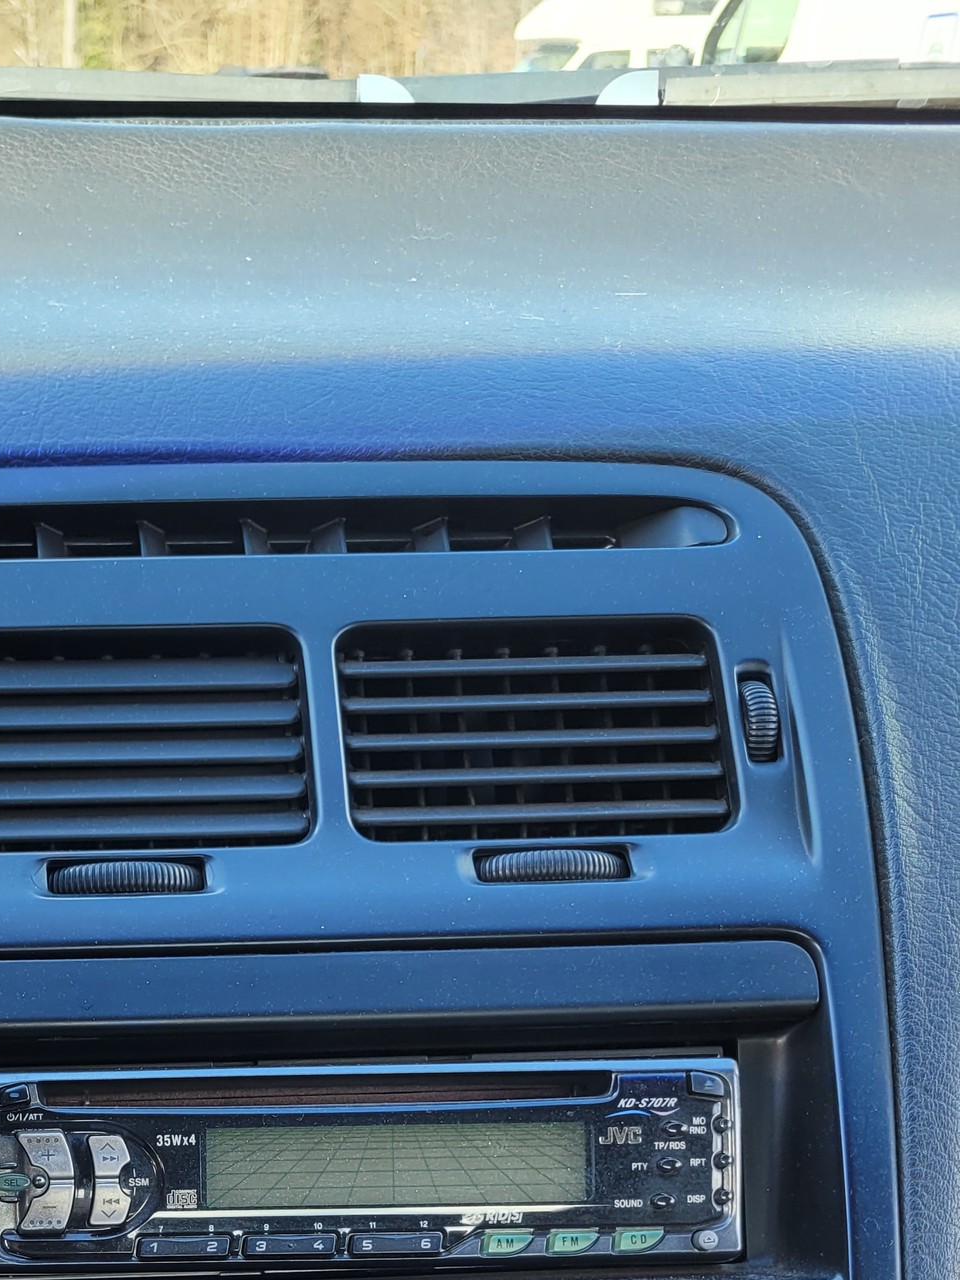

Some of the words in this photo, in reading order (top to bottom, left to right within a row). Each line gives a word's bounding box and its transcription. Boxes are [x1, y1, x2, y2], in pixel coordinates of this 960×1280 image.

[617, 1097, 678, 1108] KD-S707R
[689, 1126, 707, 1135] RND
[599, 1126, 642, 1145] JVC
[156, 1134, 197, 1147] 35Wx4
[653, 1141, 687, 1150] TP/RDS
[631, 1162, 648, 1171] PTY
[689, 1158, 707, 1167] RPT
[3, 1178, 21, 1187] SEL
[128, 1178, 150, 1186] SSM
[686, 1194, 706, 1203] DISP
[613, 1199, 644, 1208] SOUND
[263, 1223, 270, 1231] 9
[313, 1222, 323, 1230] 10
[369, 1221, 377, 1229] 11
[419, 1220, 429, 1228] 12
[149, 1242, 158, 1253] 1
[206, 1241, 218, 1252] 2
[255, 1240, 267, 1251] 3
[313, 1240, 325, 1251] 4
[361, 1239, 373, 1250] 5
[420, 1238, 432, 1249] 6
[496, 1238, 514, 1248] AM
[562, 1236, 579, 1246] FM
[630, 1234, 647, 1245] CD
